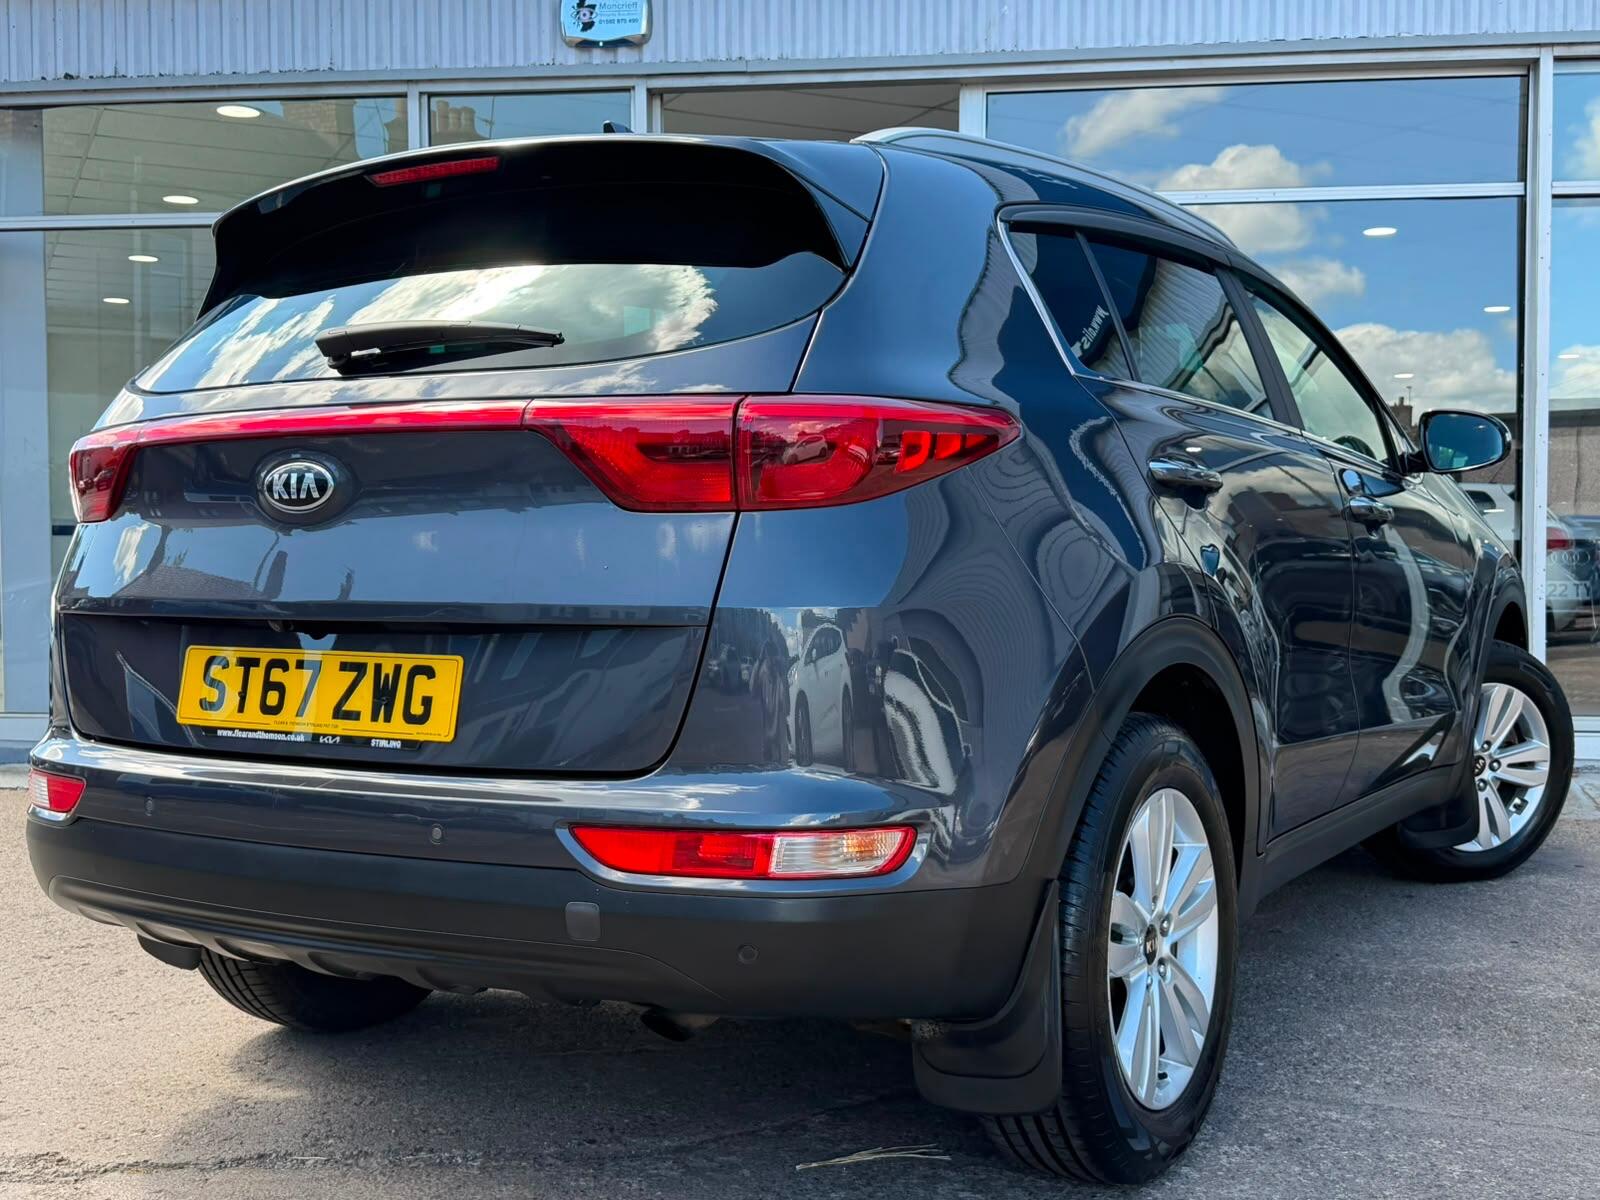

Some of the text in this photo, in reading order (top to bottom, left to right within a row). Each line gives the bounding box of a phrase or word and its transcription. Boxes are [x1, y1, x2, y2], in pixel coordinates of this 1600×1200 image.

[599, 2, 638, 10] Moncrieff
[273, 472, 320, 500] KIA
[199, 655, 437, 726] ST67 ZWG
[370, 738, 402, 749] STIRLING
